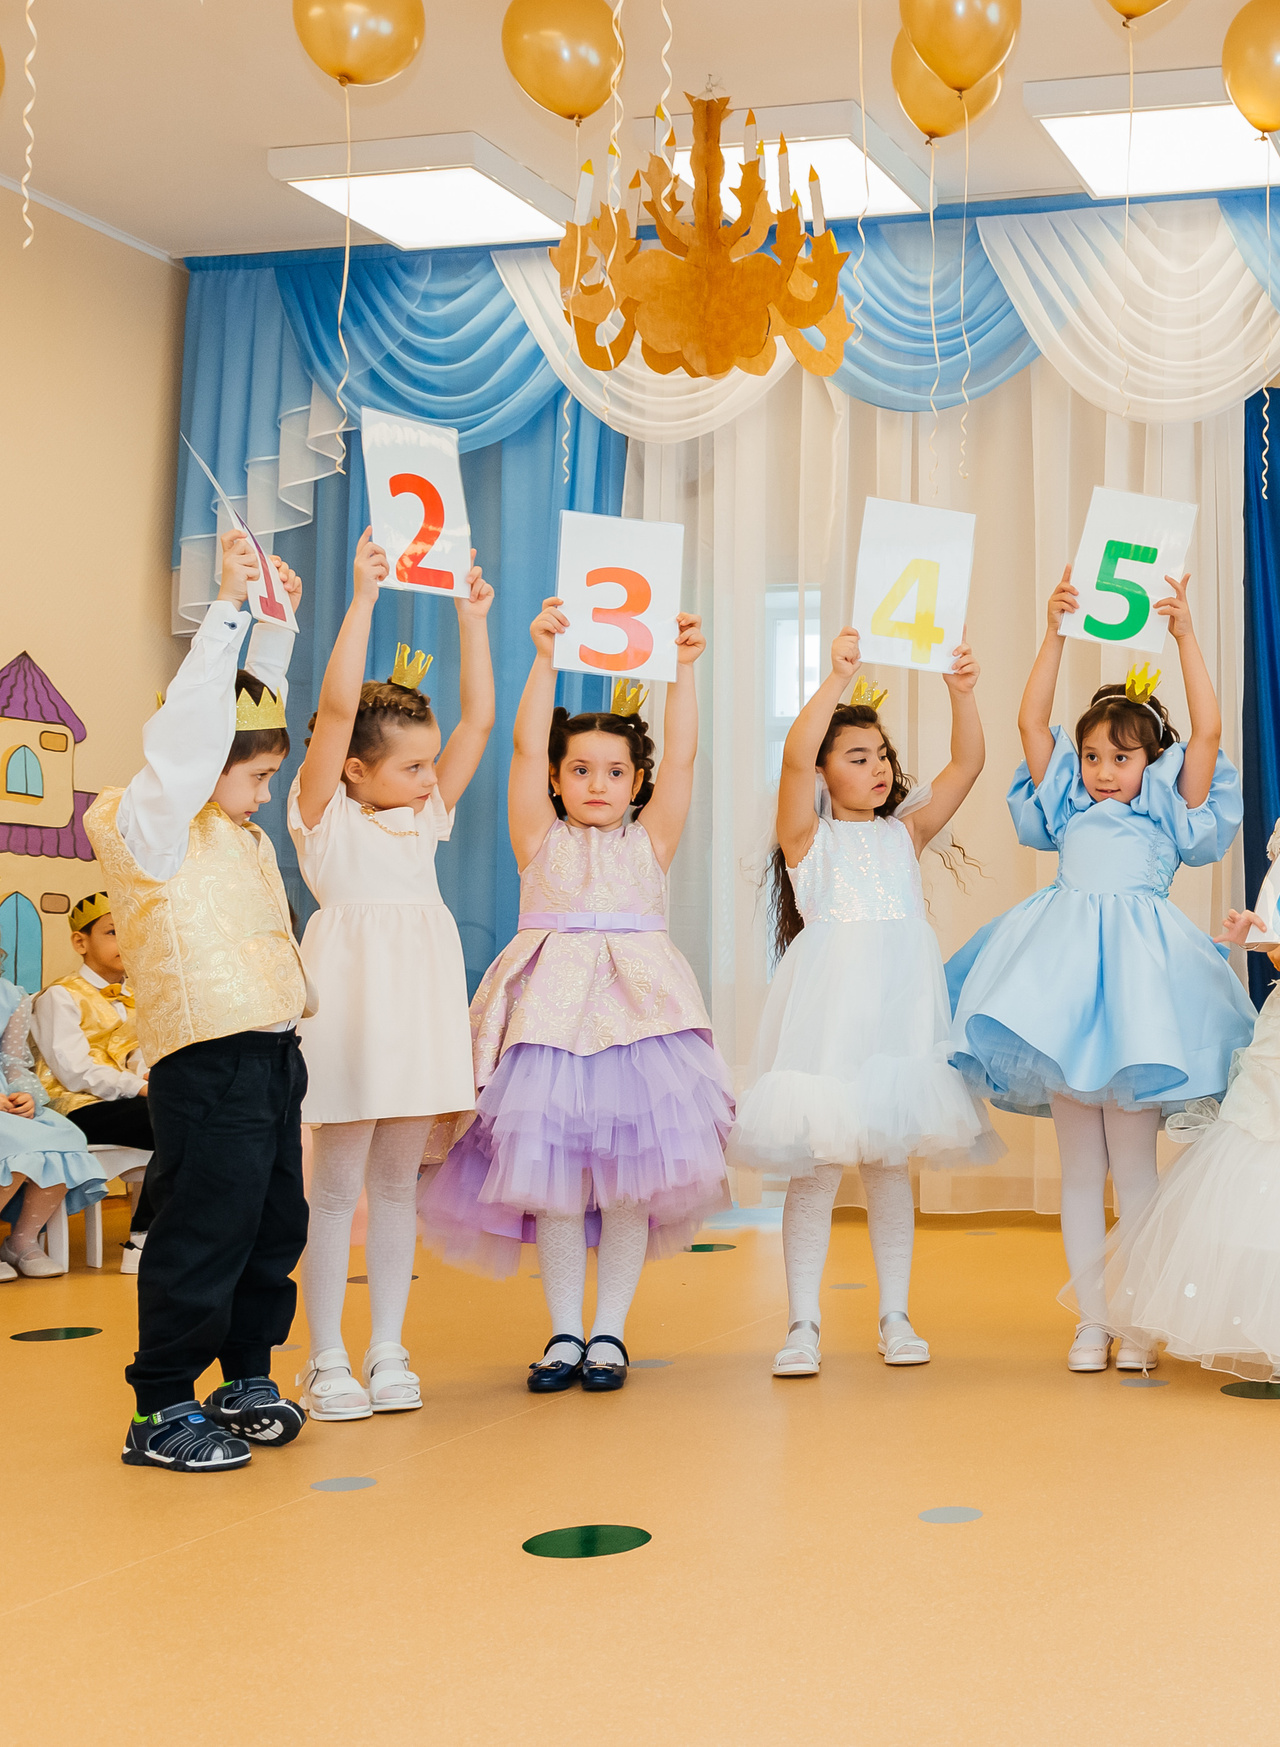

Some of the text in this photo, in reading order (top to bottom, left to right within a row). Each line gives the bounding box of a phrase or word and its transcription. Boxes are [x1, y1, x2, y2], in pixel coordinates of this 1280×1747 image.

[234, 509, 287, 622] 1
[388, 473, 454, 589] 2
[578, 566, 654, 671] 3
[871, 558, 944, 664] 4
[1083, 539, 1158, 641] 5
